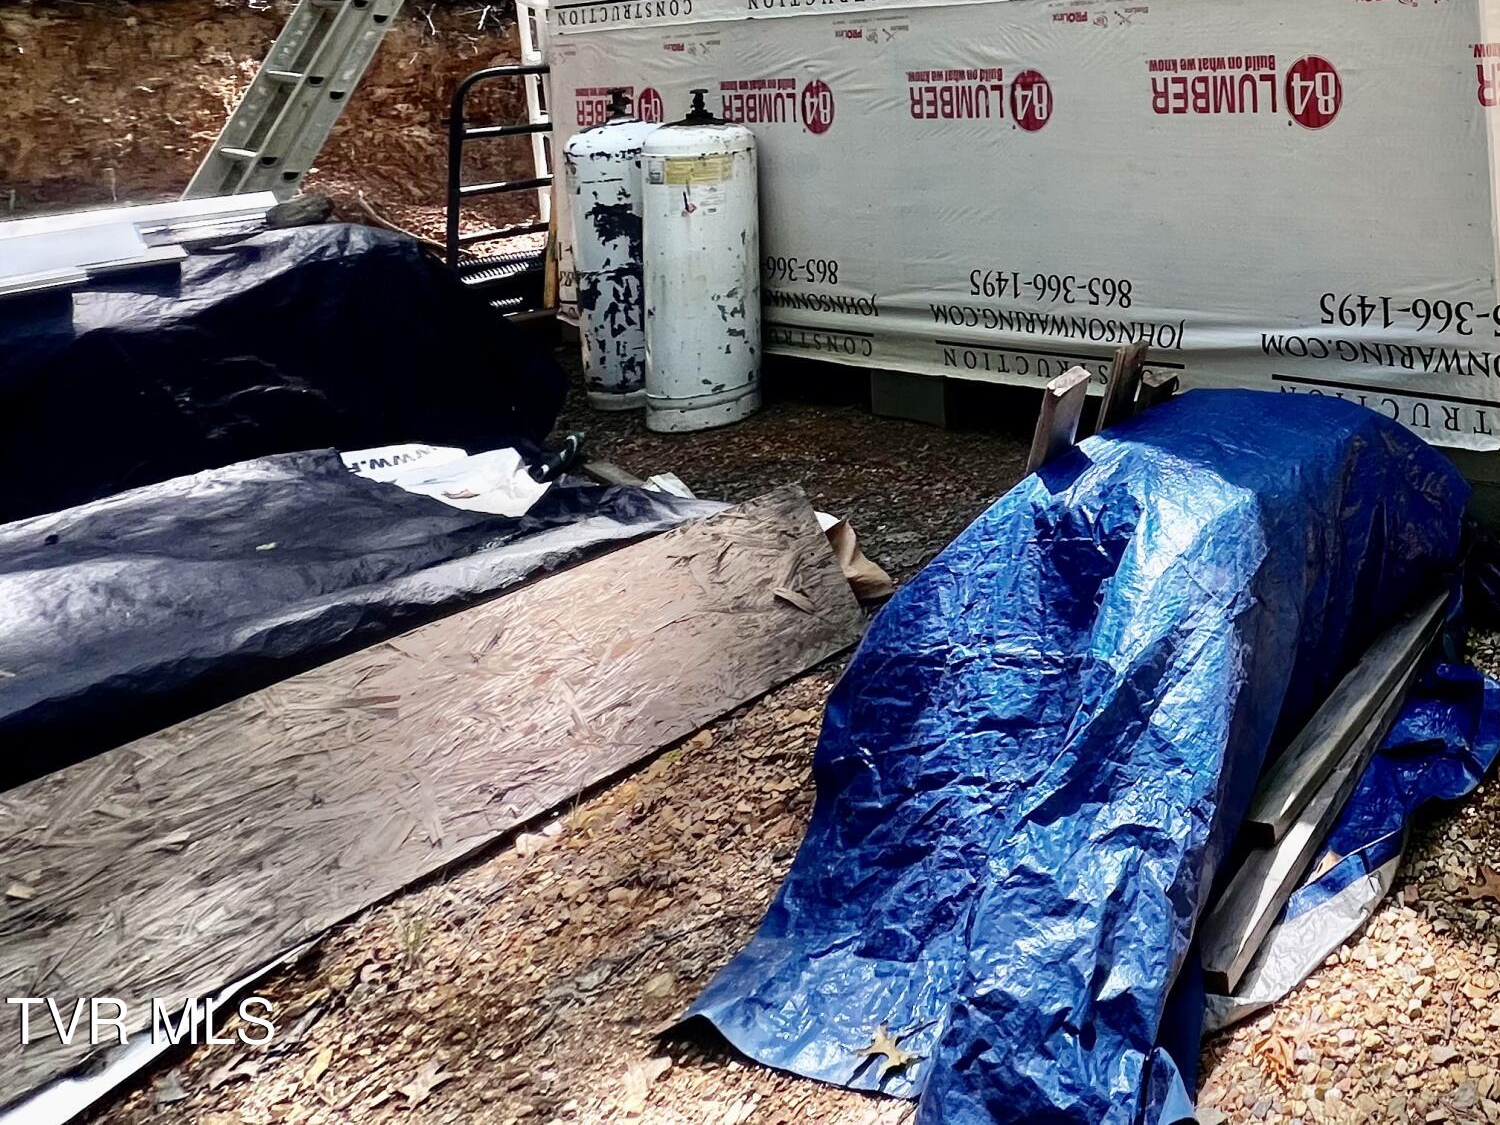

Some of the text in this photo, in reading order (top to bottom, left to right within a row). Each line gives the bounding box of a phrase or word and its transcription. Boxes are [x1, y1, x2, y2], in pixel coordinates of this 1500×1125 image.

[1179, 58, 1196, 71] we
[1198, 57, 1225, 72] what
[1228, 57, 1242, 70] on
[1246, 55, 1275, 72] Build
[721, 93, 797, 124] LUMBER
[909, 84, 1004, 119] LUMBER
[1151, 74, 1277, 114] LUMBER
[576, 96, 634, 126] LBER
[765, 289, 879, 317] JOHNSONWA
[969, 268, 1132, 309] 865-366-1495
[929, 304, 1185, 350] JOHNSONWARING.COM
[767, 329, 873, 357] CONSTRU
